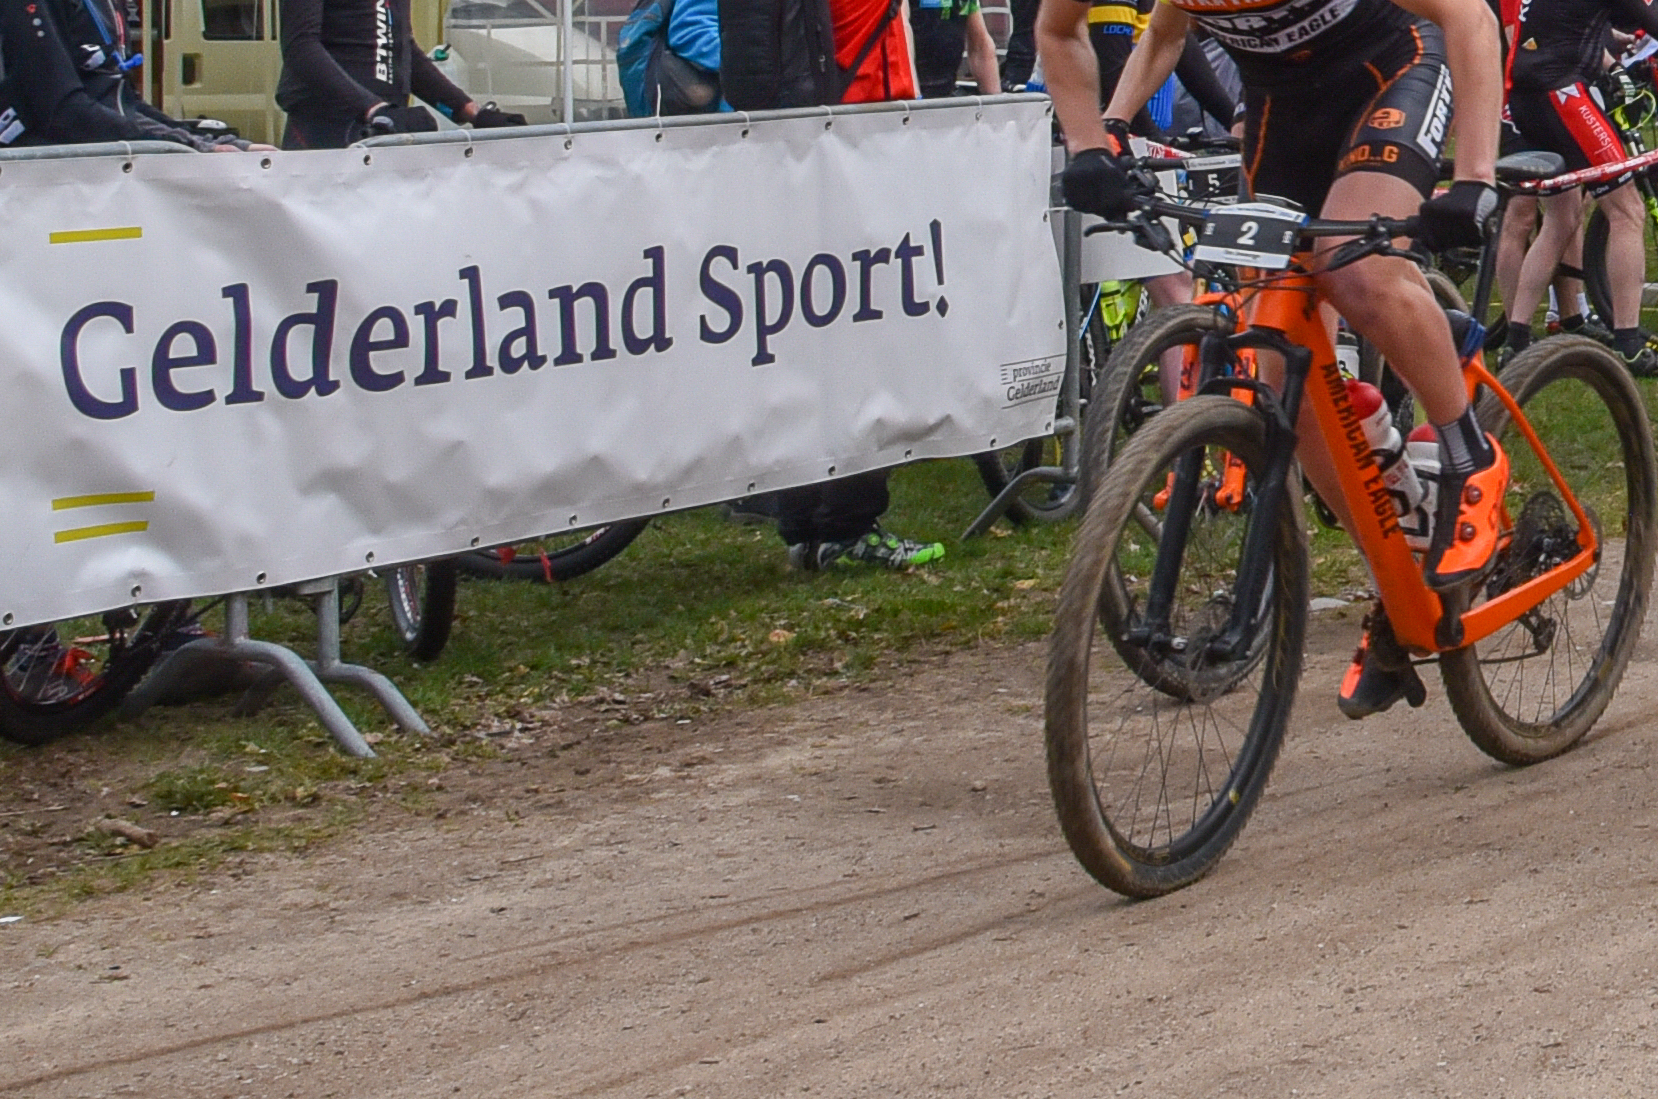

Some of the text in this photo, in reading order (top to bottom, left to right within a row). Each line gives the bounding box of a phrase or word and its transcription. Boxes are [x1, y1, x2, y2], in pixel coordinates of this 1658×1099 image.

[1287, 6, 1341, 44] EAGLE
[1207, 173, 1221, 194] 5
[1236, 221, 1259, 246] 2
[59, 217, 950, 421] Gelderland Sport!
[1012, 359, 1052, 380] provincie
[1006, 375, 1062, 403] Gelderland
[1320, 361, 1402, 541] AMERICAN EAGLE
